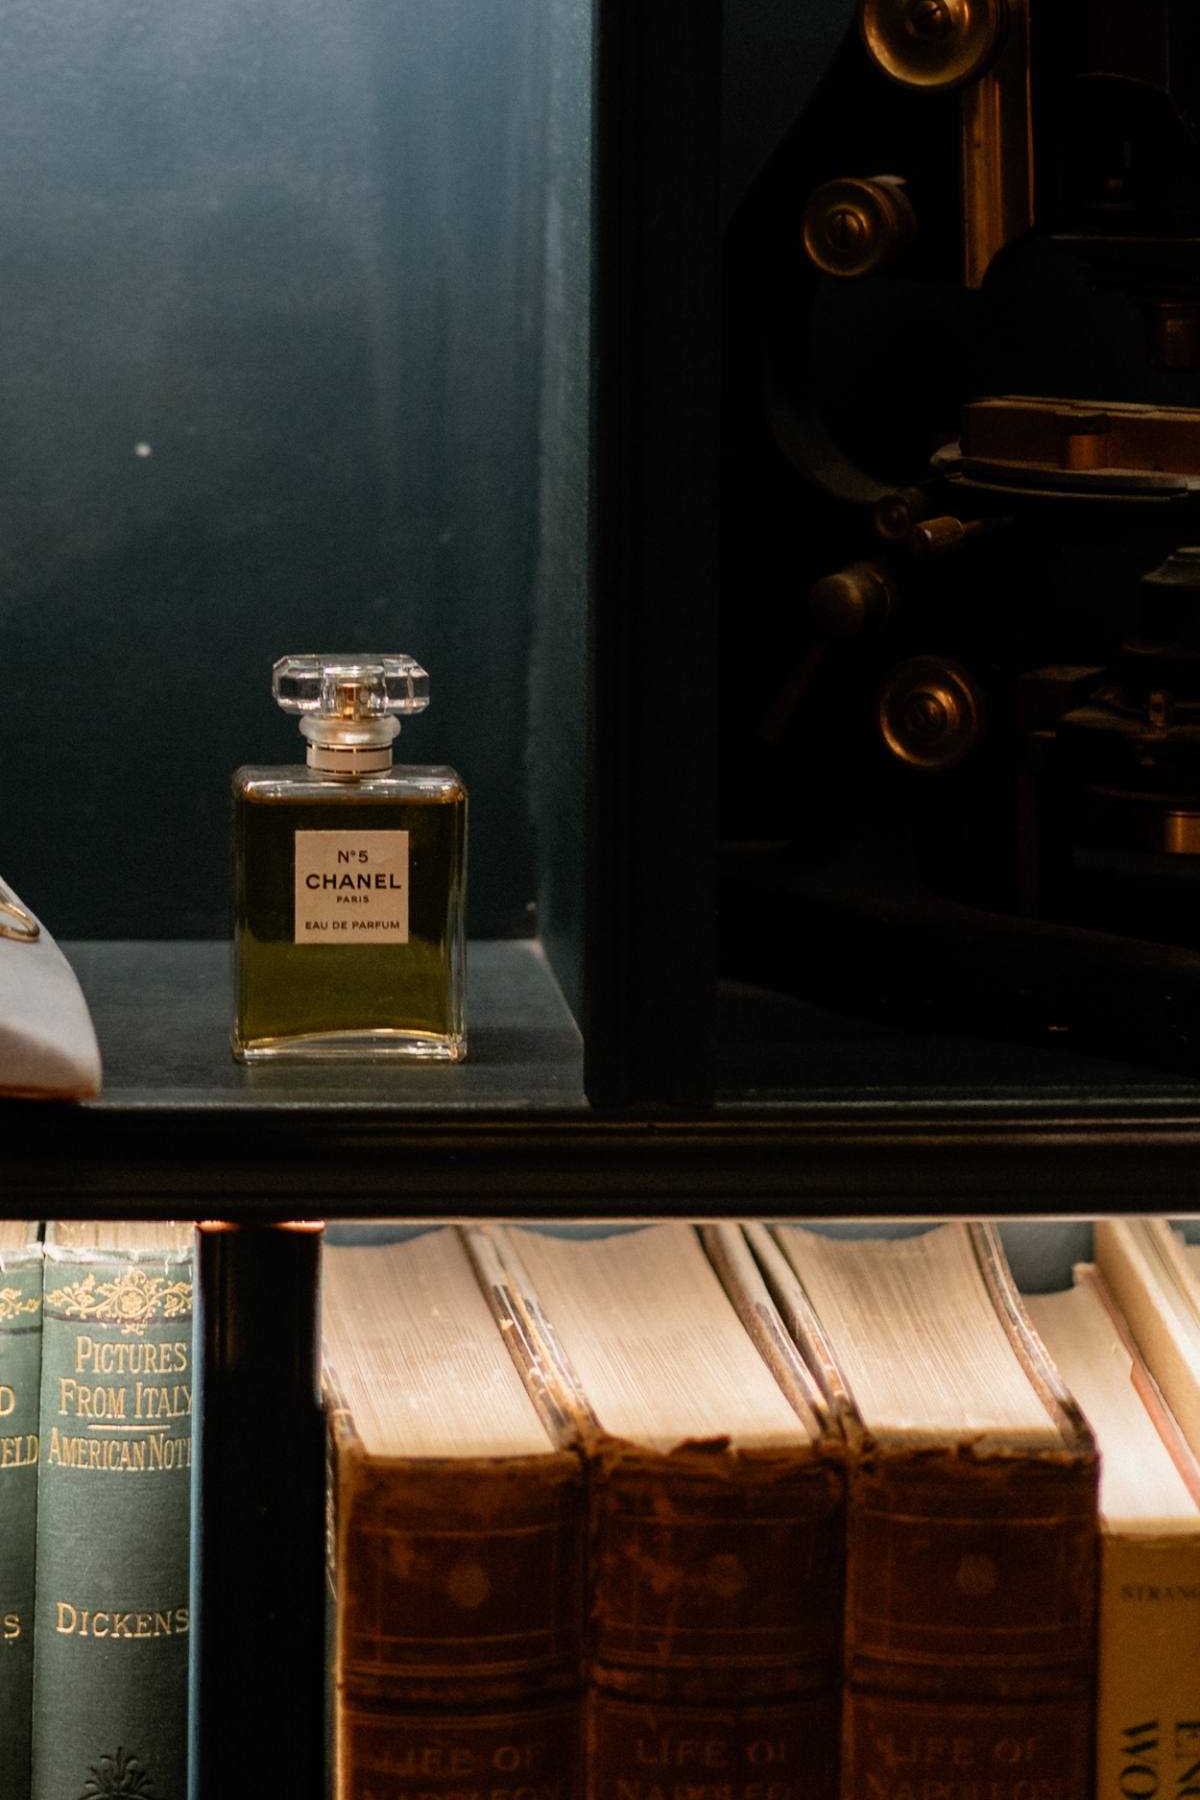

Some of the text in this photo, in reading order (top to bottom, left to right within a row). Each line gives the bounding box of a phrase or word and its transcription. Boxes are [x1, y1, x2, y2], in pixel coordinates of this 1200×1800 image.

[305, 873, 402, 890] CHANEL
[336, 896, 370, 904] PARIS
[305, 921, 400, 930] EAU DE PARFUM
[76, 1334, 187, 1374] PICTURES
[58, 1376, 192, 1418] FROM ITALY
[47, 1426, 191, 1472] AMERICAN NOT
[56, 1602, 190, 1639] DICKENS
[635, 1738, 728, 1768] LIFE
